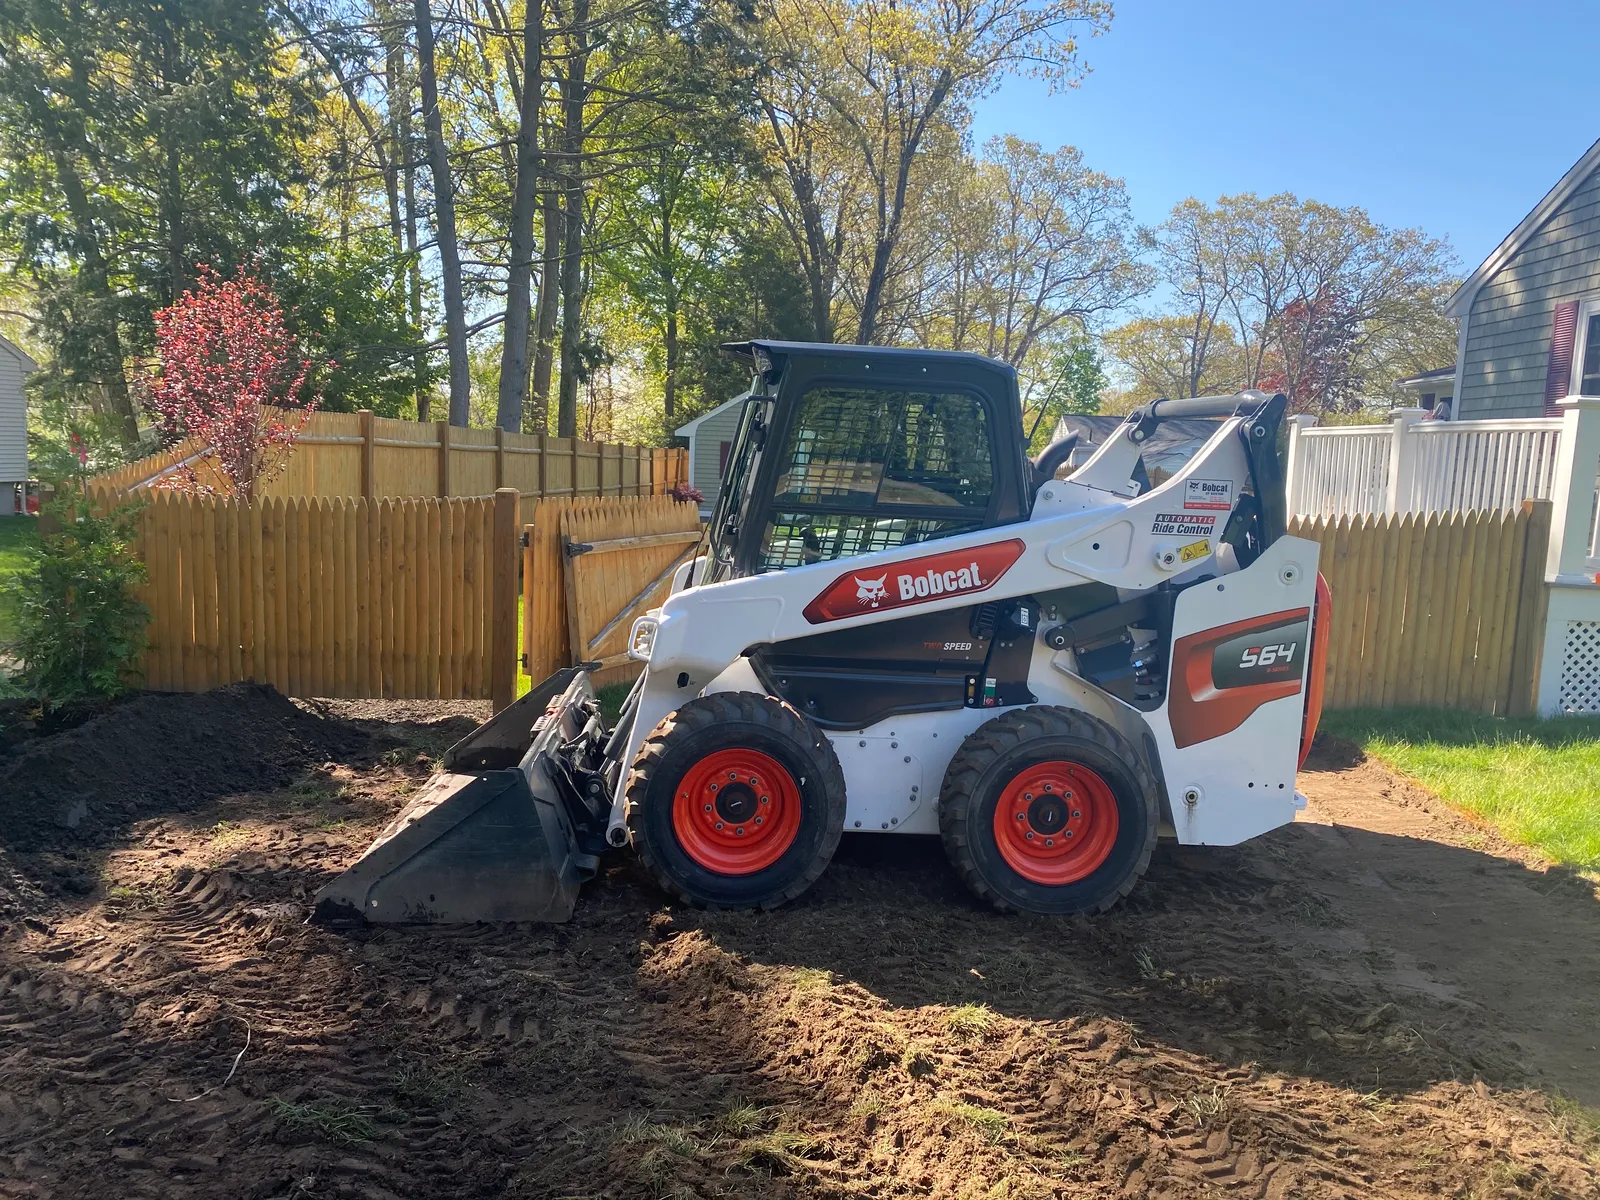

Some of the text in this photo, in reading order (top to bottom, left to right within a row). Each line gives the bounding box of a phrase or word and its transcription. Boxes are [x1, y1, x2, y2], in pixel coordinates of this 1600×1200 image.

[1202, 483, 1228, 492] Bobcat
[1157, 514, 1214, 524] AUTOMATIC
[1151, 523, 1214, 535] Ride Control
[897, 562, 982, 600] Bobcat
[924, 642, 972, 651] TWO SPEED
[1239, 642, 1297, 668] S64
